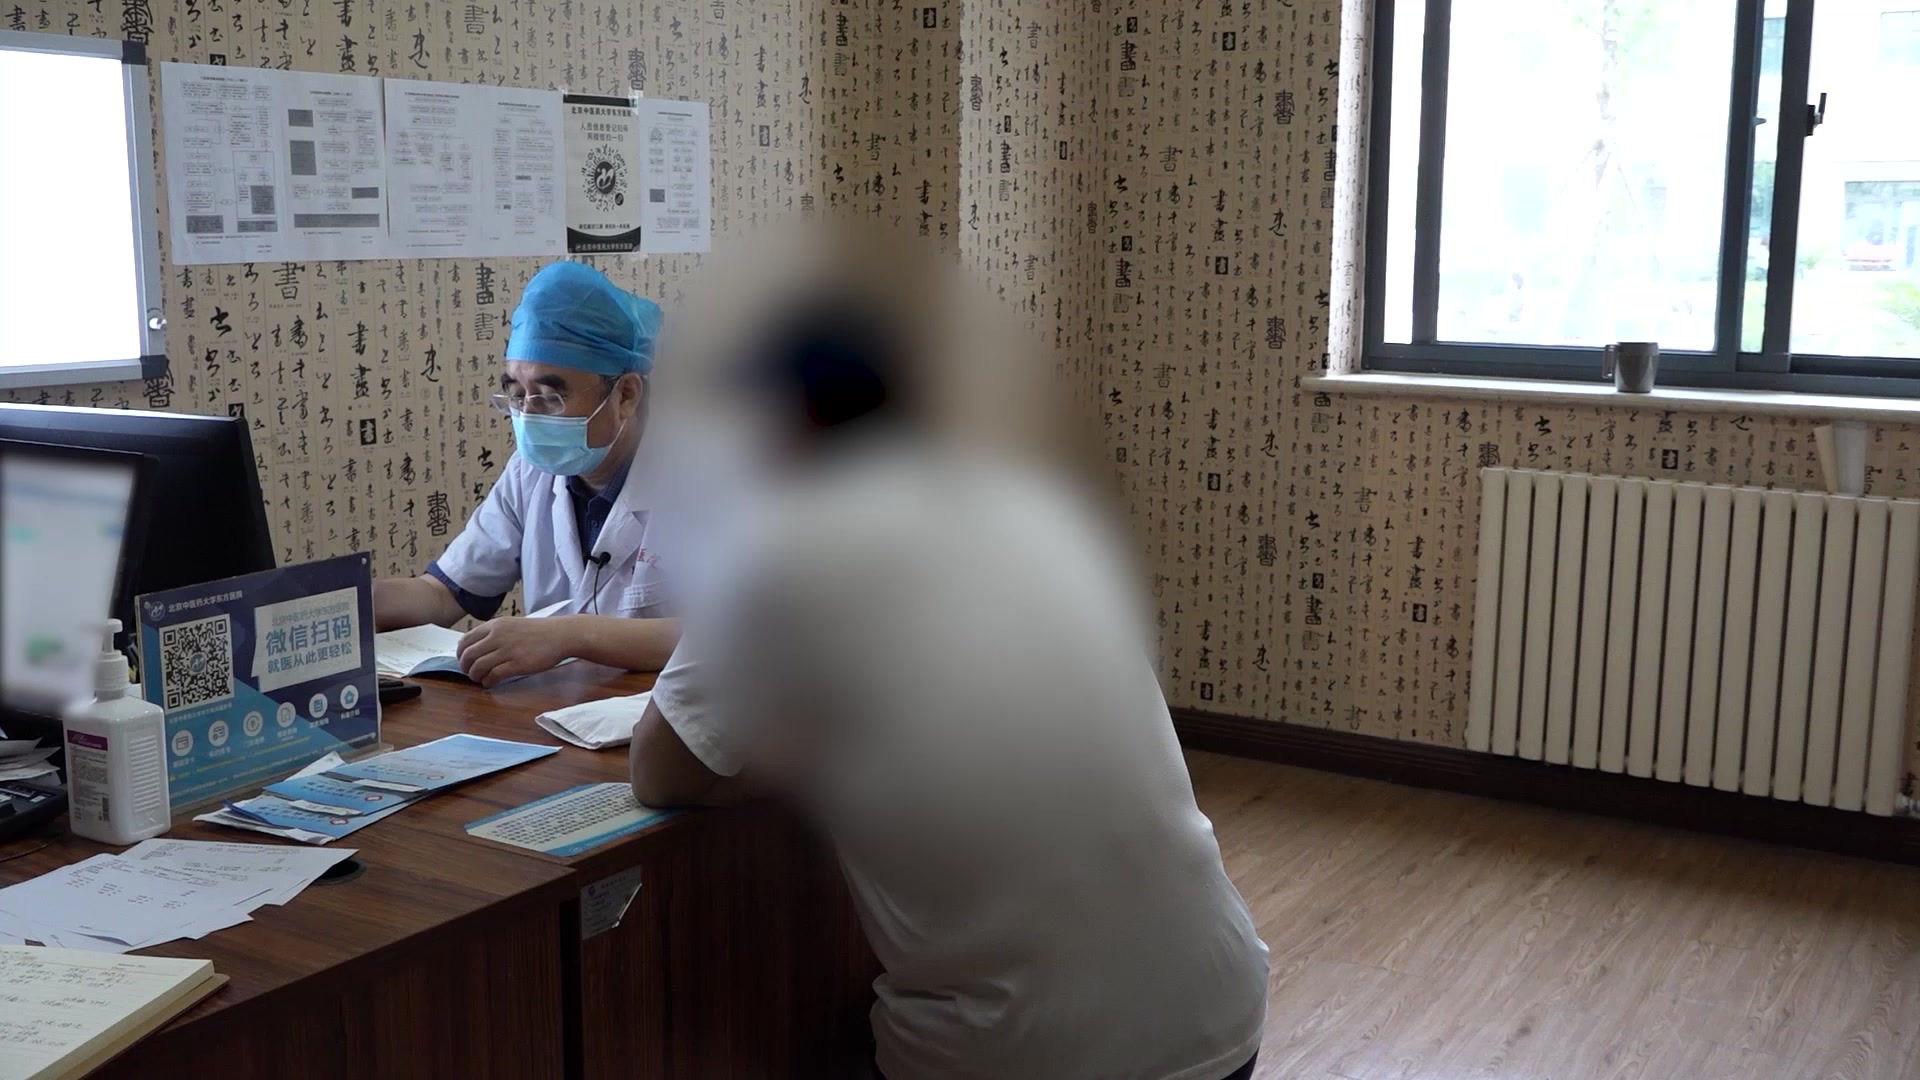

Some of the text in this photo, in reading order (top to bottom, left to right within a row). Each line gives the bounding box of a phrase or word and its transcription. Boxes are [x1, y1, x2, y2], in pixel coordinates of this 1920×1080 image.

[168, 590, 243, 614] 北京中医药大学东方医院
[265, 614, 352, 656] 微信扫码
[267, 644, 352, 674] 就医从此更轻松
